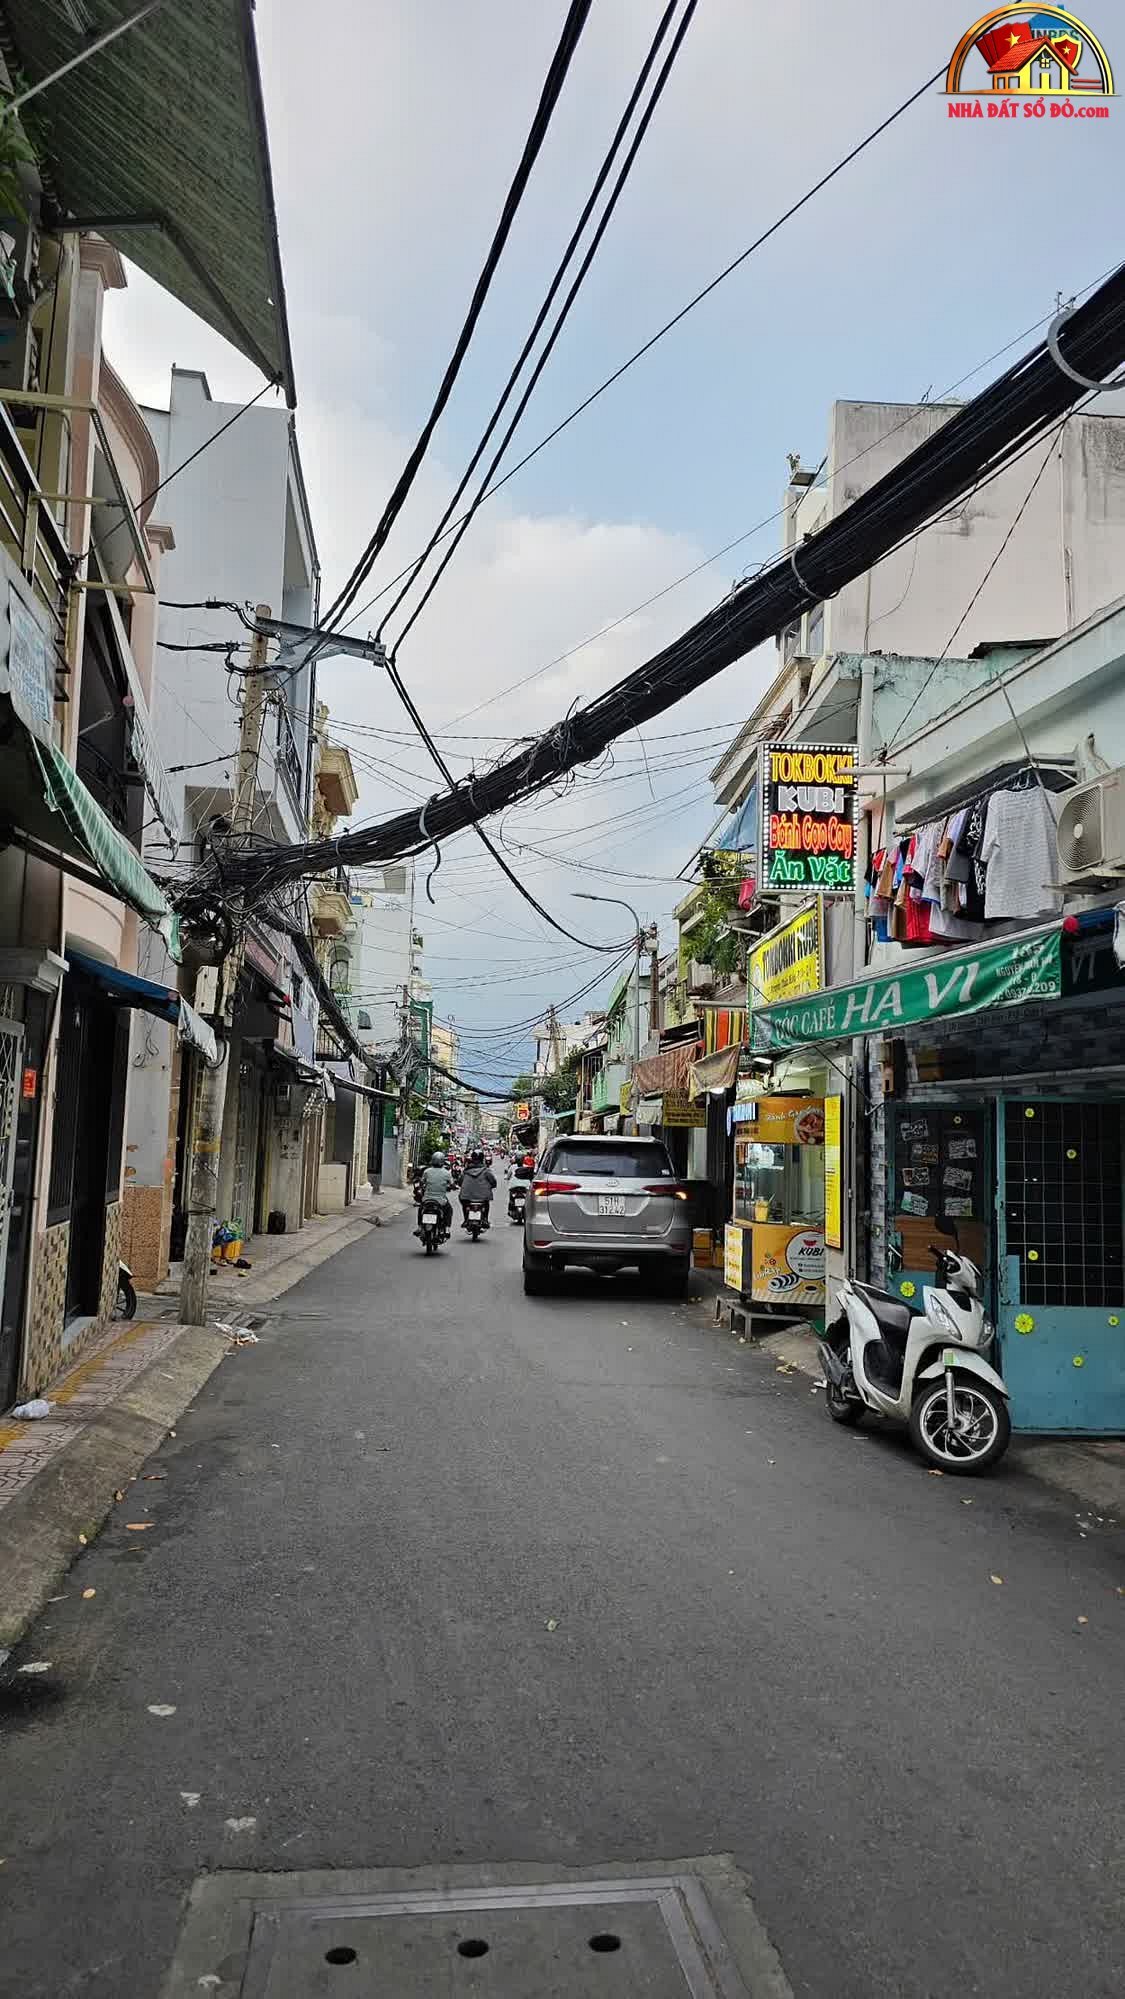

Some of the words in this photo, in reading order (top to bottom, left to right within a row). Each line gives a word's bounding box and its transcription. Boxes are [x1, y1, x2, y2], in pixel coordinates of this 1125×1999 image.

[778, 785, 845, 813] KUBI
[828, 816, 853, 859] Cay
[769, 850, 805, 881] Ăn
[807, 855, 851, 886] Vặt
[801, 999, 836, 1037] CAFÉ
[841, 981, 903, 1028] HẠ
[923, 961, 981, 1009] VI
